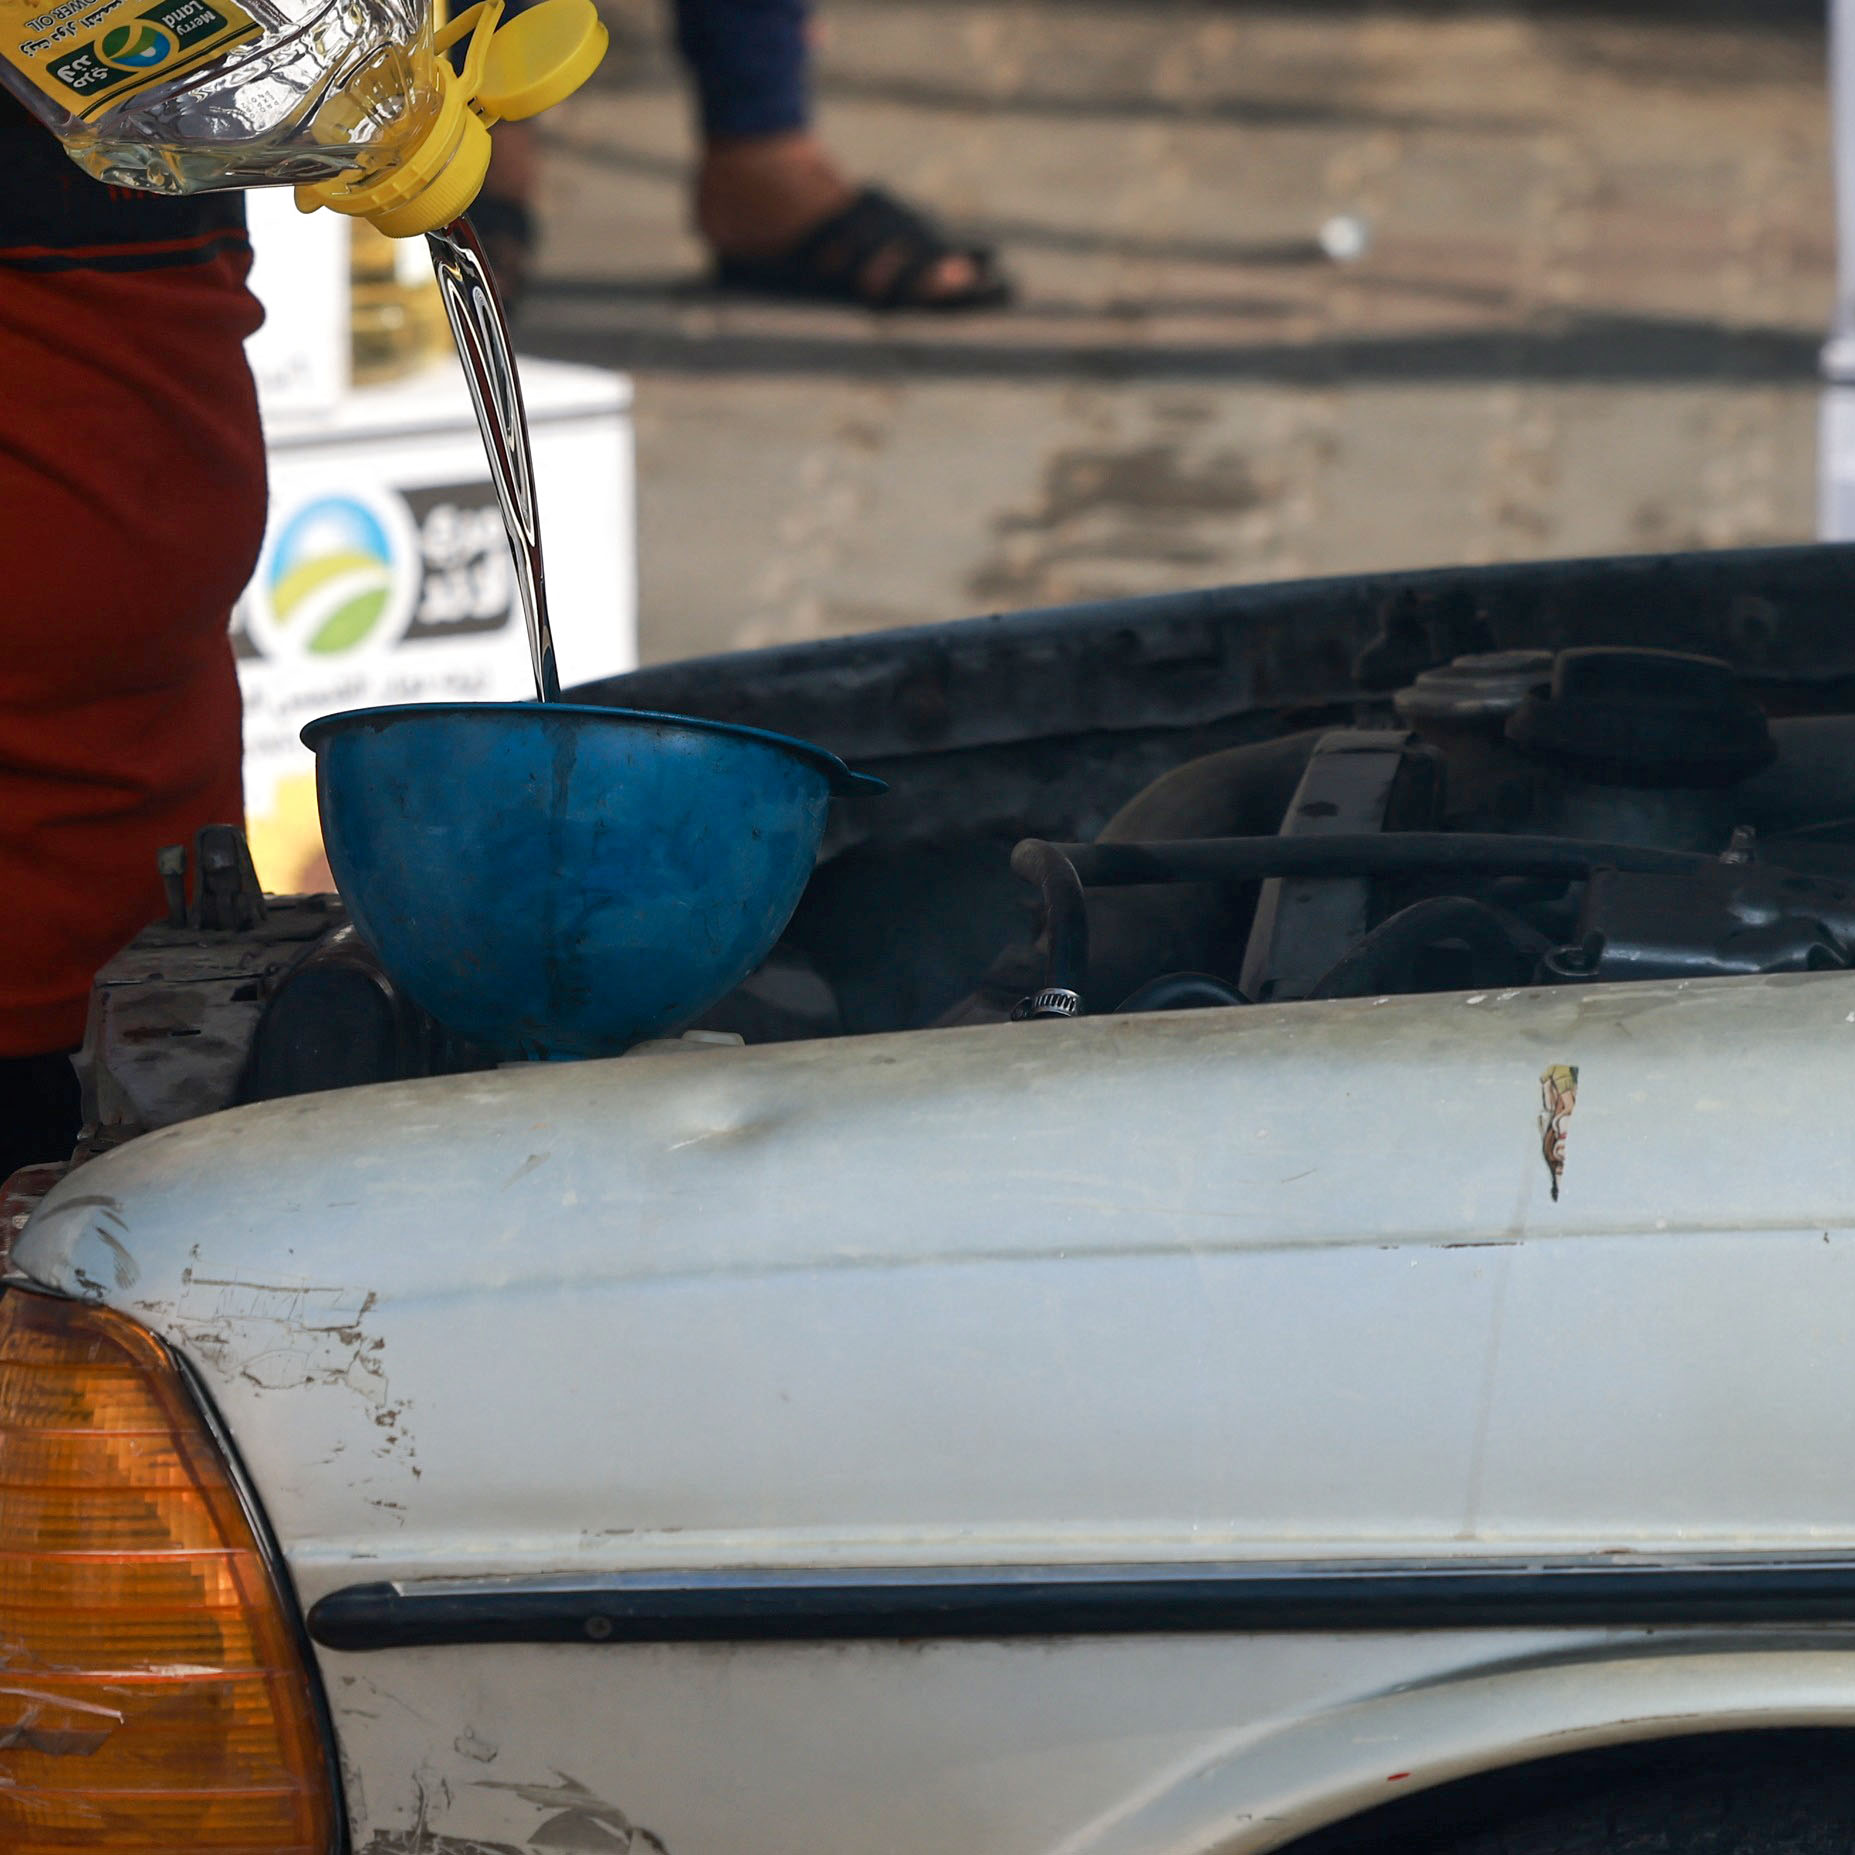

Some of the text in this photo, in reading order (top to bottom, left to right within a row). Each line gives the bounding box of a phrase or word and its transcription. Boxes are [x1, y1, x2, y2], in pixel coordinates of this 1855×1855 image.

[25, 13, 56, 33] OIL
[162, 0, 204, 28] Land
[176, 10, 217, 36] Merry
[19, 39, 52, 57] زيت
[51, 20, 77, 43] دوار
[57, 55, 92, 83] لاند
[73, 67, 109, 88] مري
